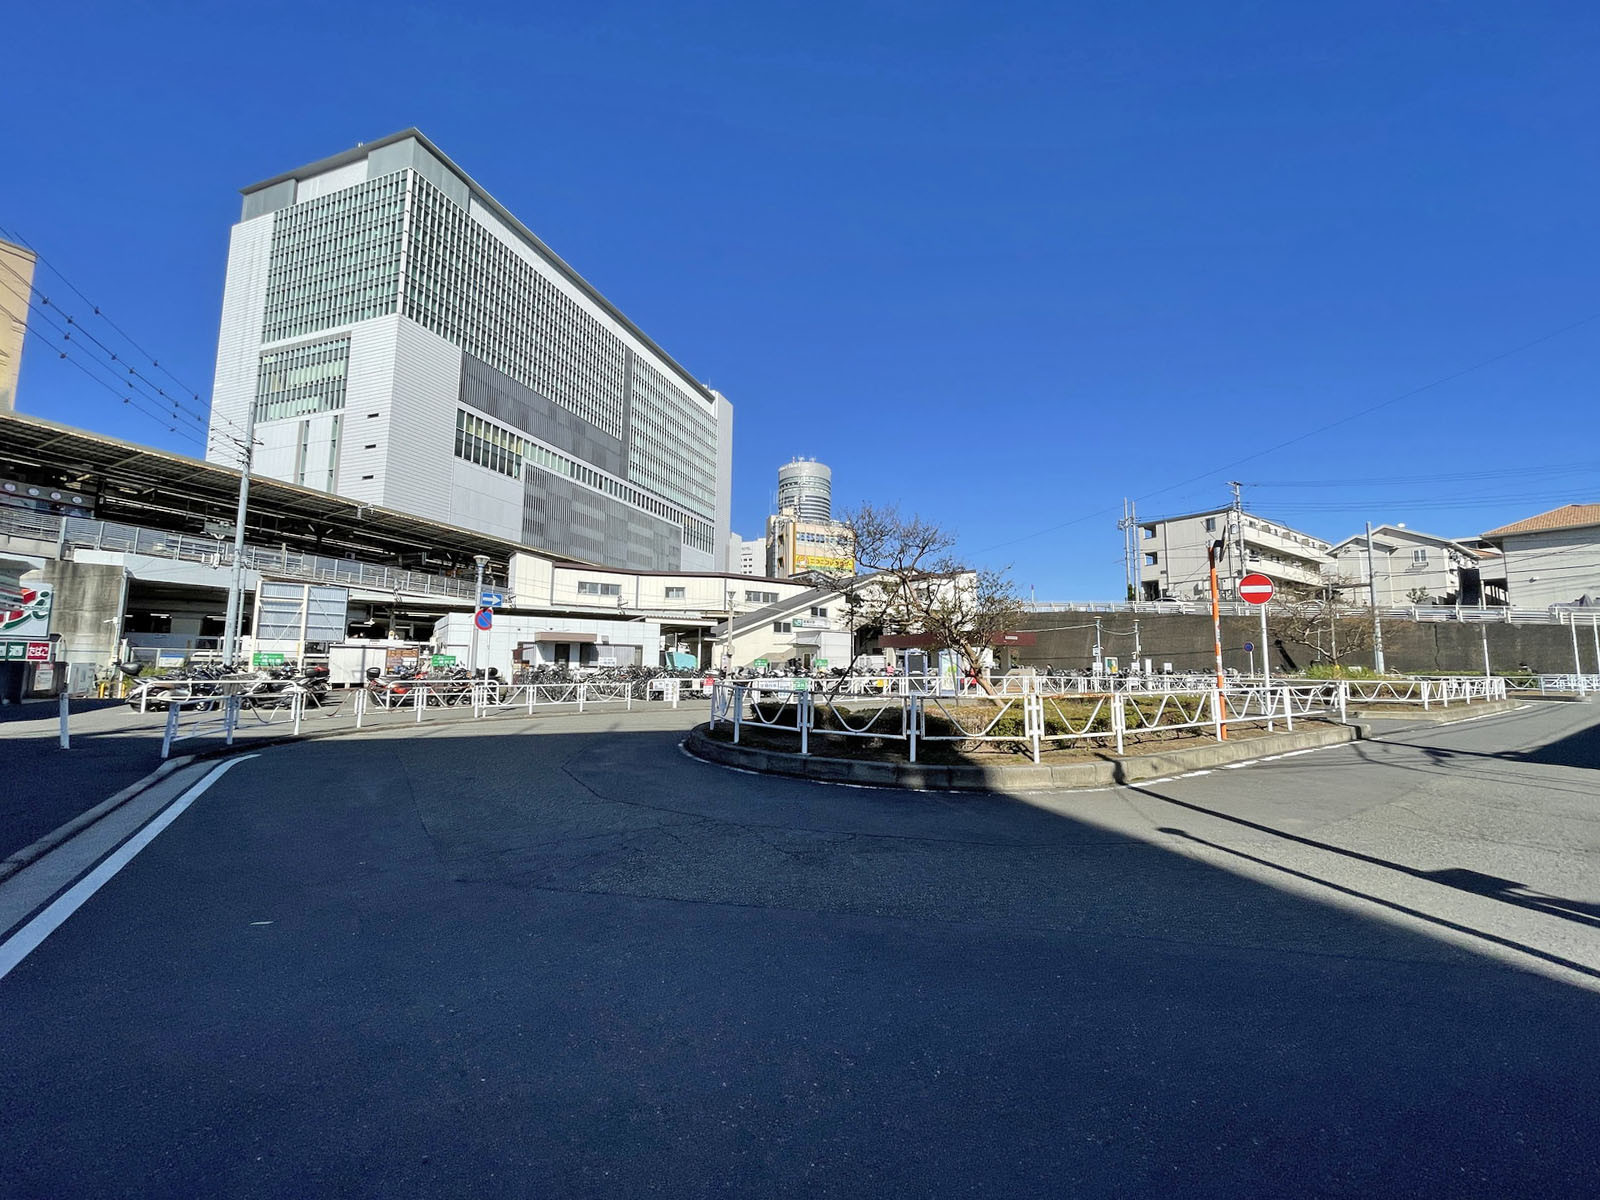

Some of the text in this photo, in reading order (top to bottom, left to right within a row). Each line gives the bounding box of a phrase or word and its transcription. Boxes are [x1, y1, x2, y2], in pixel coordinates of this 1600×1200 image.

[9, 645, 24, 656] 酒
[28, 646, 49, 657] たばこ
